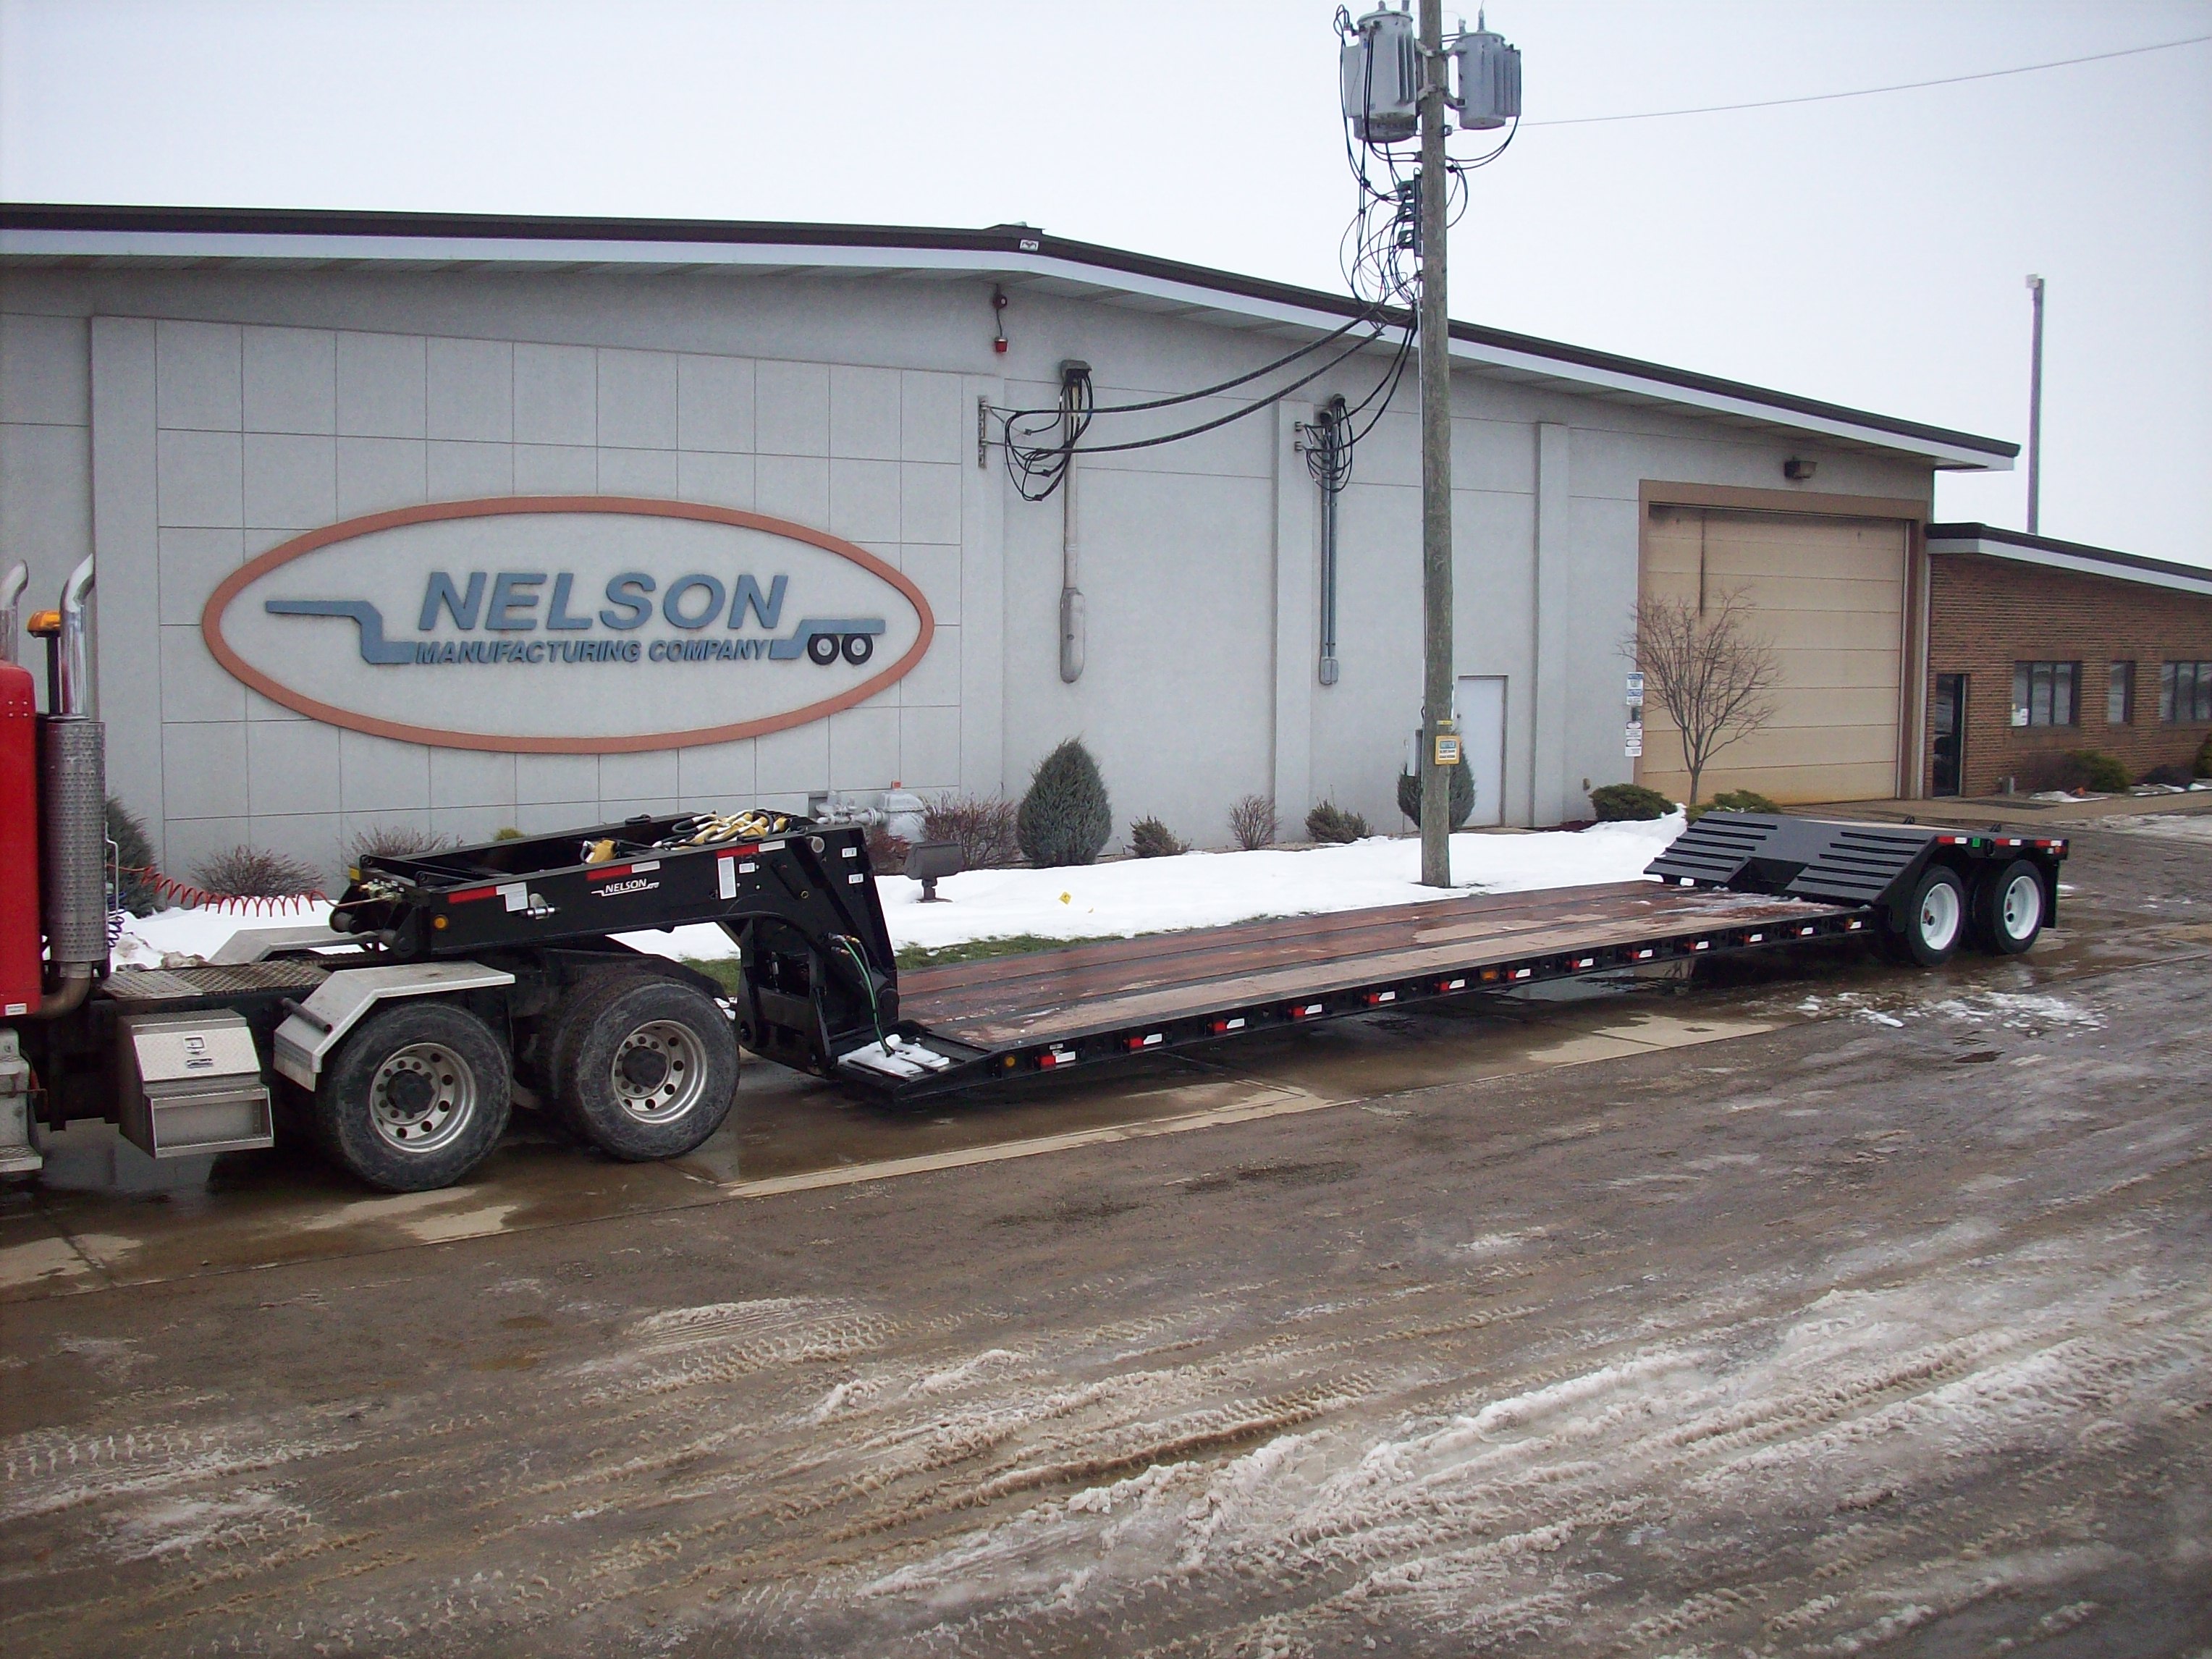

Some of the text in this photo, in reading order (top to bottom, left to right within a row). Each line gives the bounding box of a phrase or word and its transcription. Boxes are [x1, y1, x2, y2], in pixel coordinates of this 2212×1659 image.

[418, 571, 788, 630] NELSON
[415, 639, 769, 664] MANUFACTURING COMPANY
[605, 878, 647, 893] NELSON
